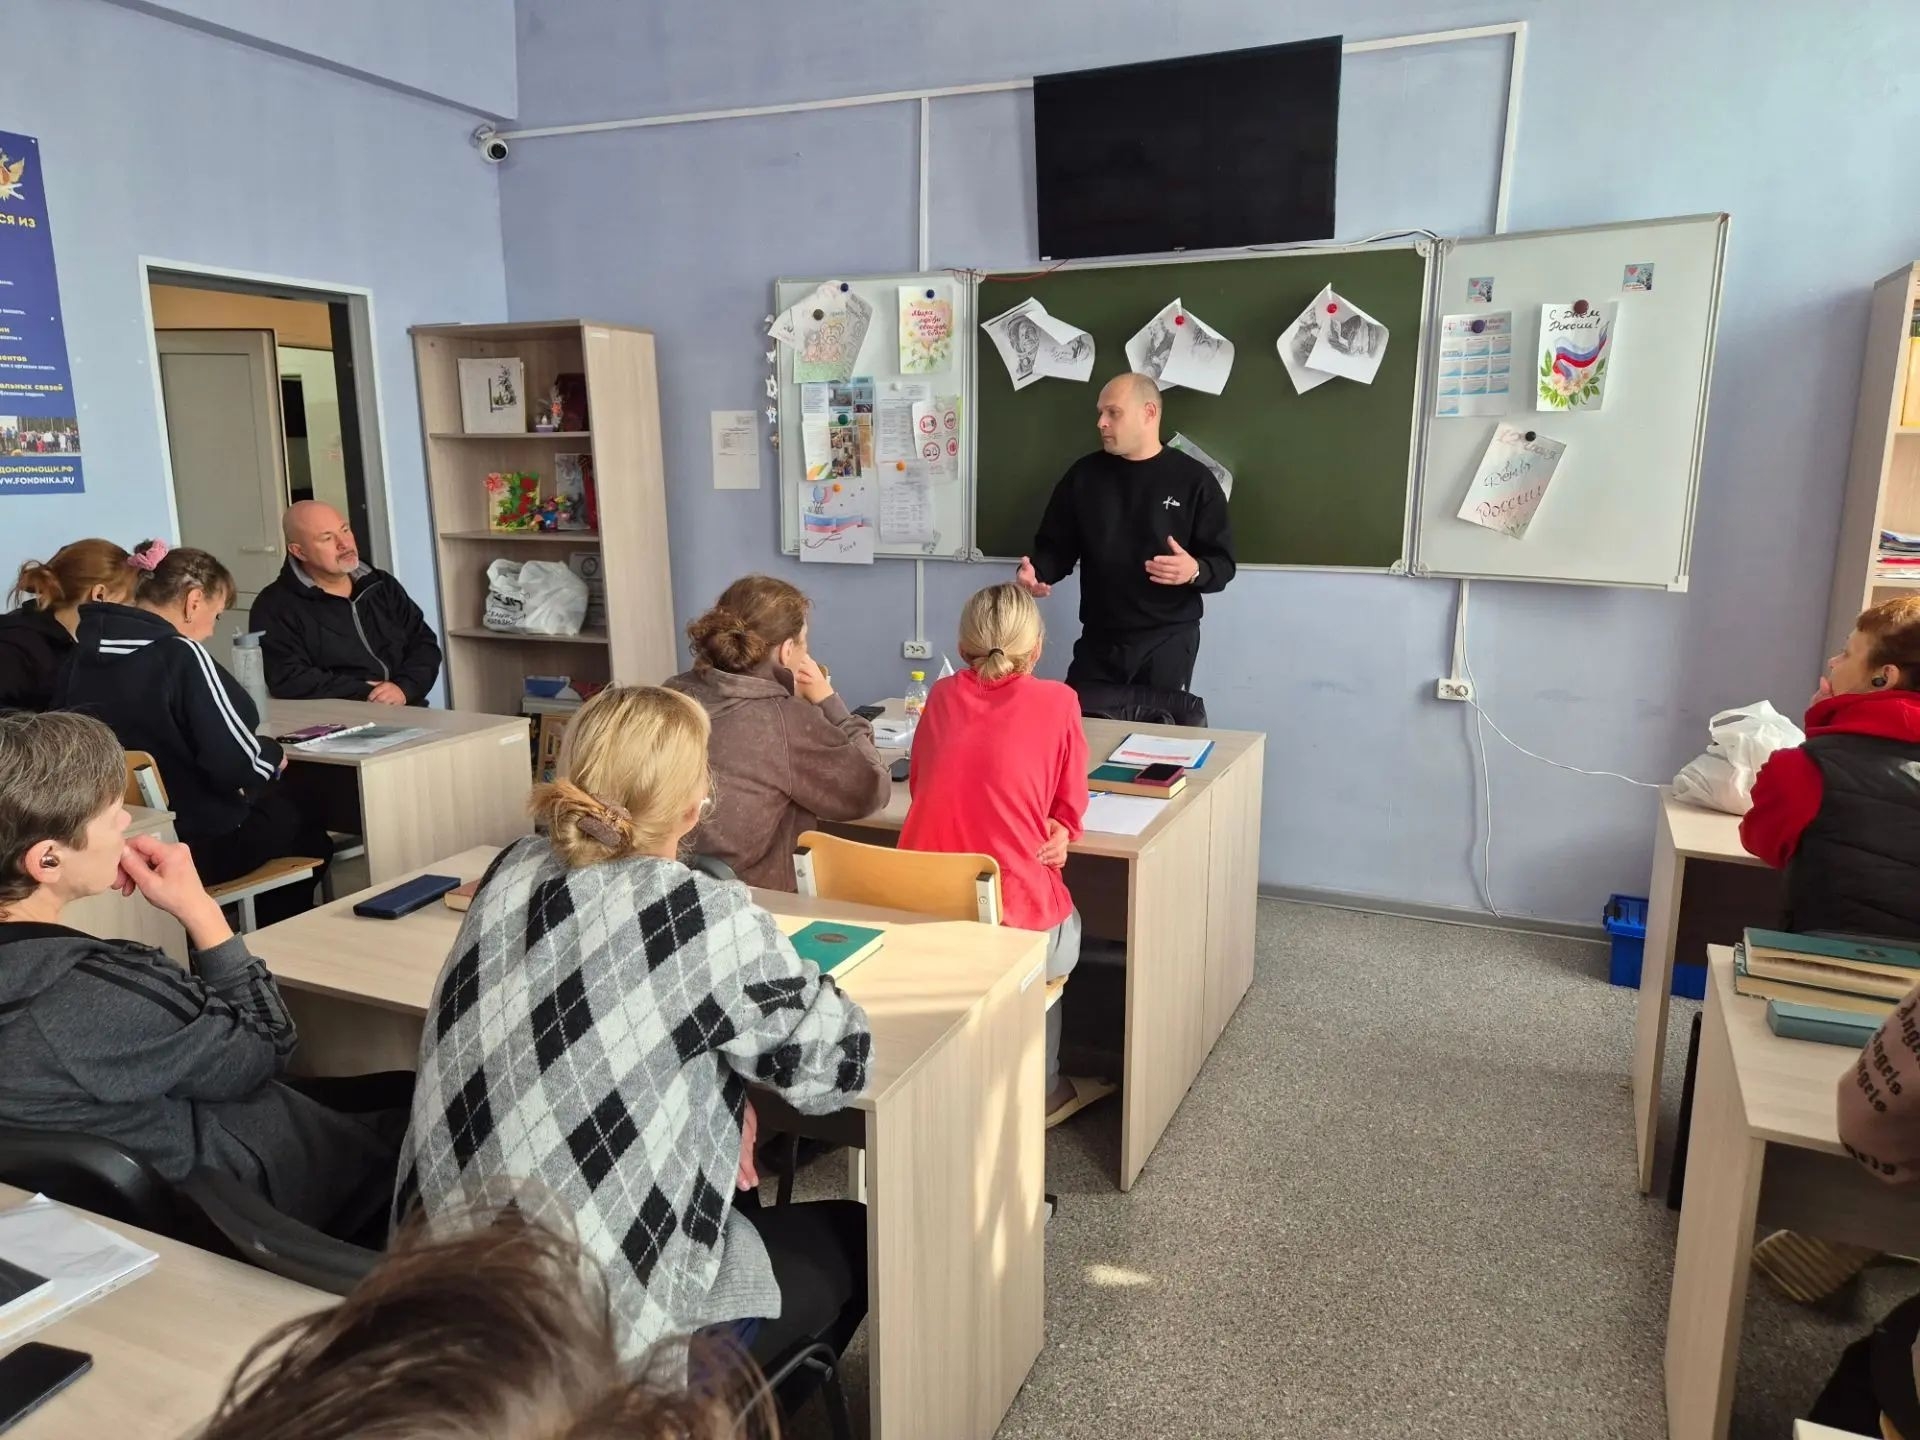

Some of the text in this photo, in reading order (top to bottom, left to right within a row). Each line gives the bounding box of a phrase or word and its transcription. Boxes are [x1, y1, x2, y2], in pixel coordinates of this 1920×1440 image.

[18, 217, 36, 228] ИЗ
[1549, 309, 1557, 320] С
[1548, 319, 1601, 332] России!
